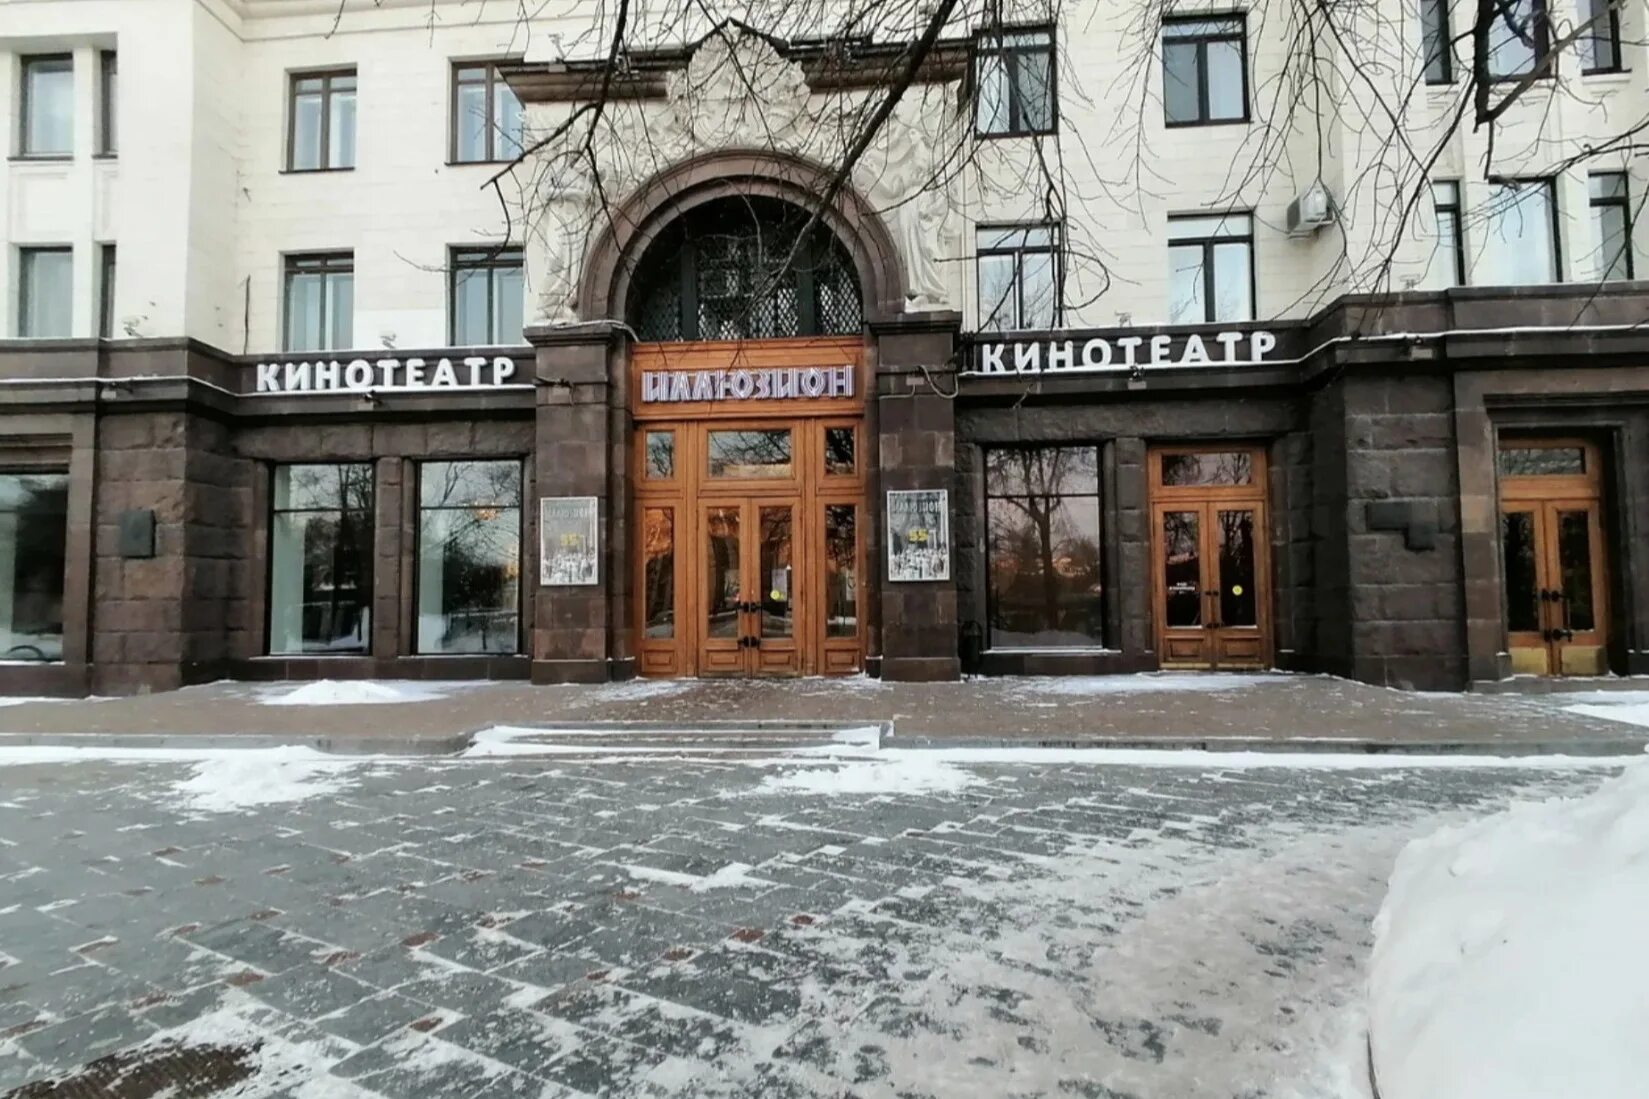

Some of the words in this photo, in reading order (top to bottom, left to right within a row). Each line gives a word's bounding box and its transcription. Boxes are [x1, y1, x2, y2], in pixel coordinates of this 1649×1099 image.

[981, 331, 1276, 373] КИНОТЕАТР
[256, 356, 515, 392] КИНОТЕАТР
[641, 364, 855, 403] ИЛЛЮЗИОН
